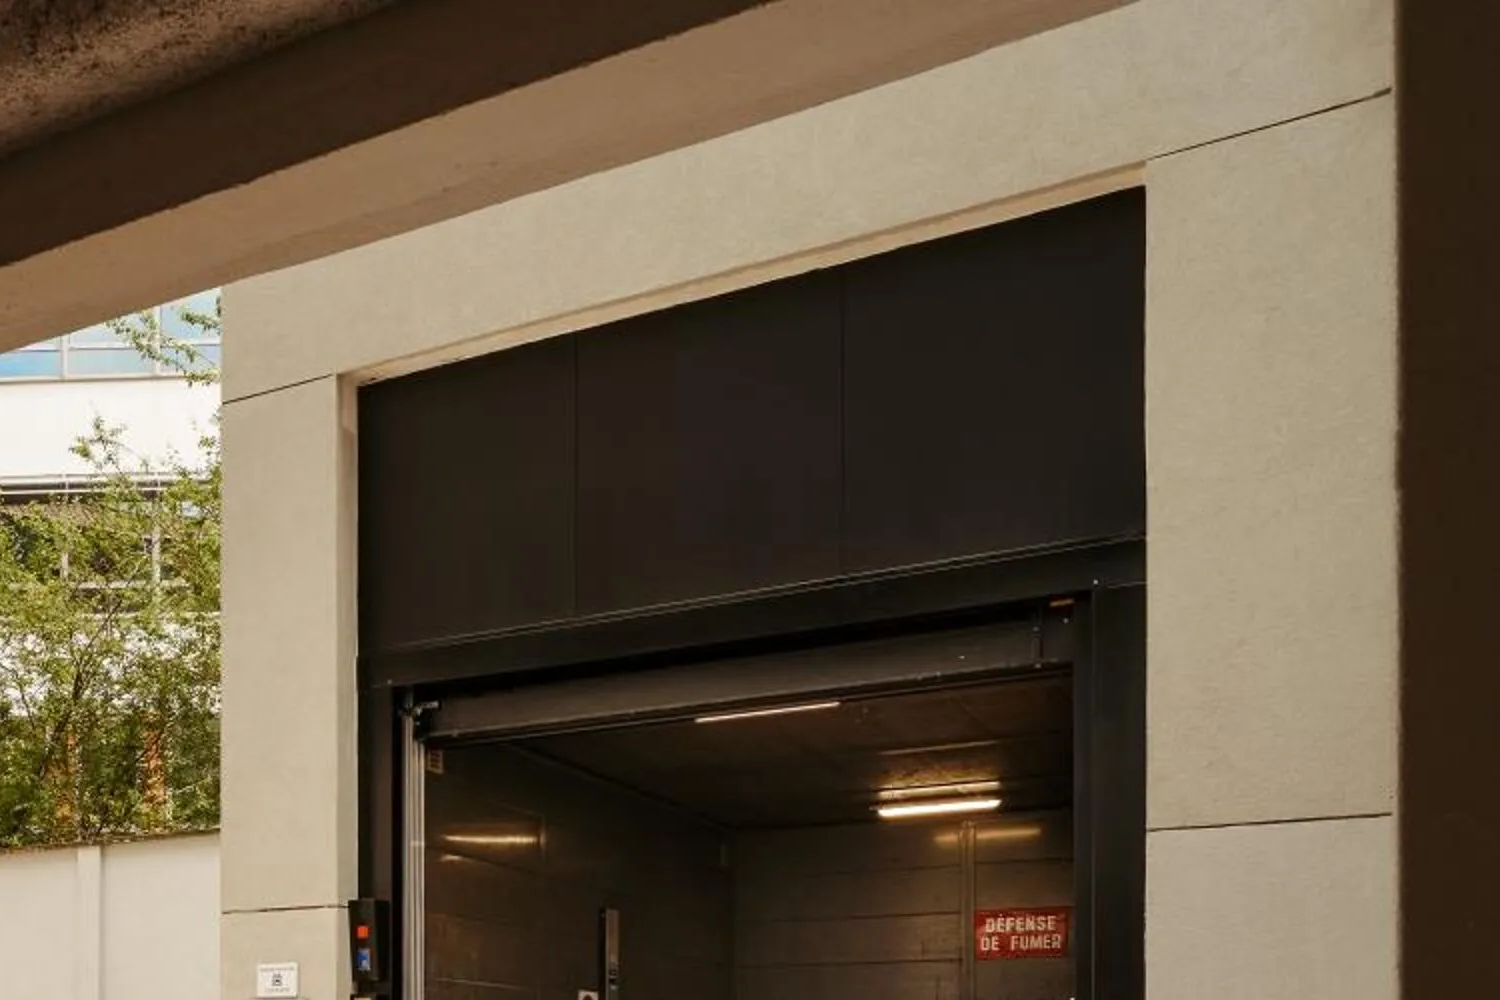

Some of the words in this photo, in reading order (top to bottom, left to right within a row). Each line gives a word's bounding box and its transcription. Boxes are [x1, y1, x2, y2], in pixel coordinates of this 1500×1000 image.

[985, 913, 1057, 933] DÉFENSE
[981, 936, 1000, 951] DE
[1010, 934, 1061, 951] FUMER
